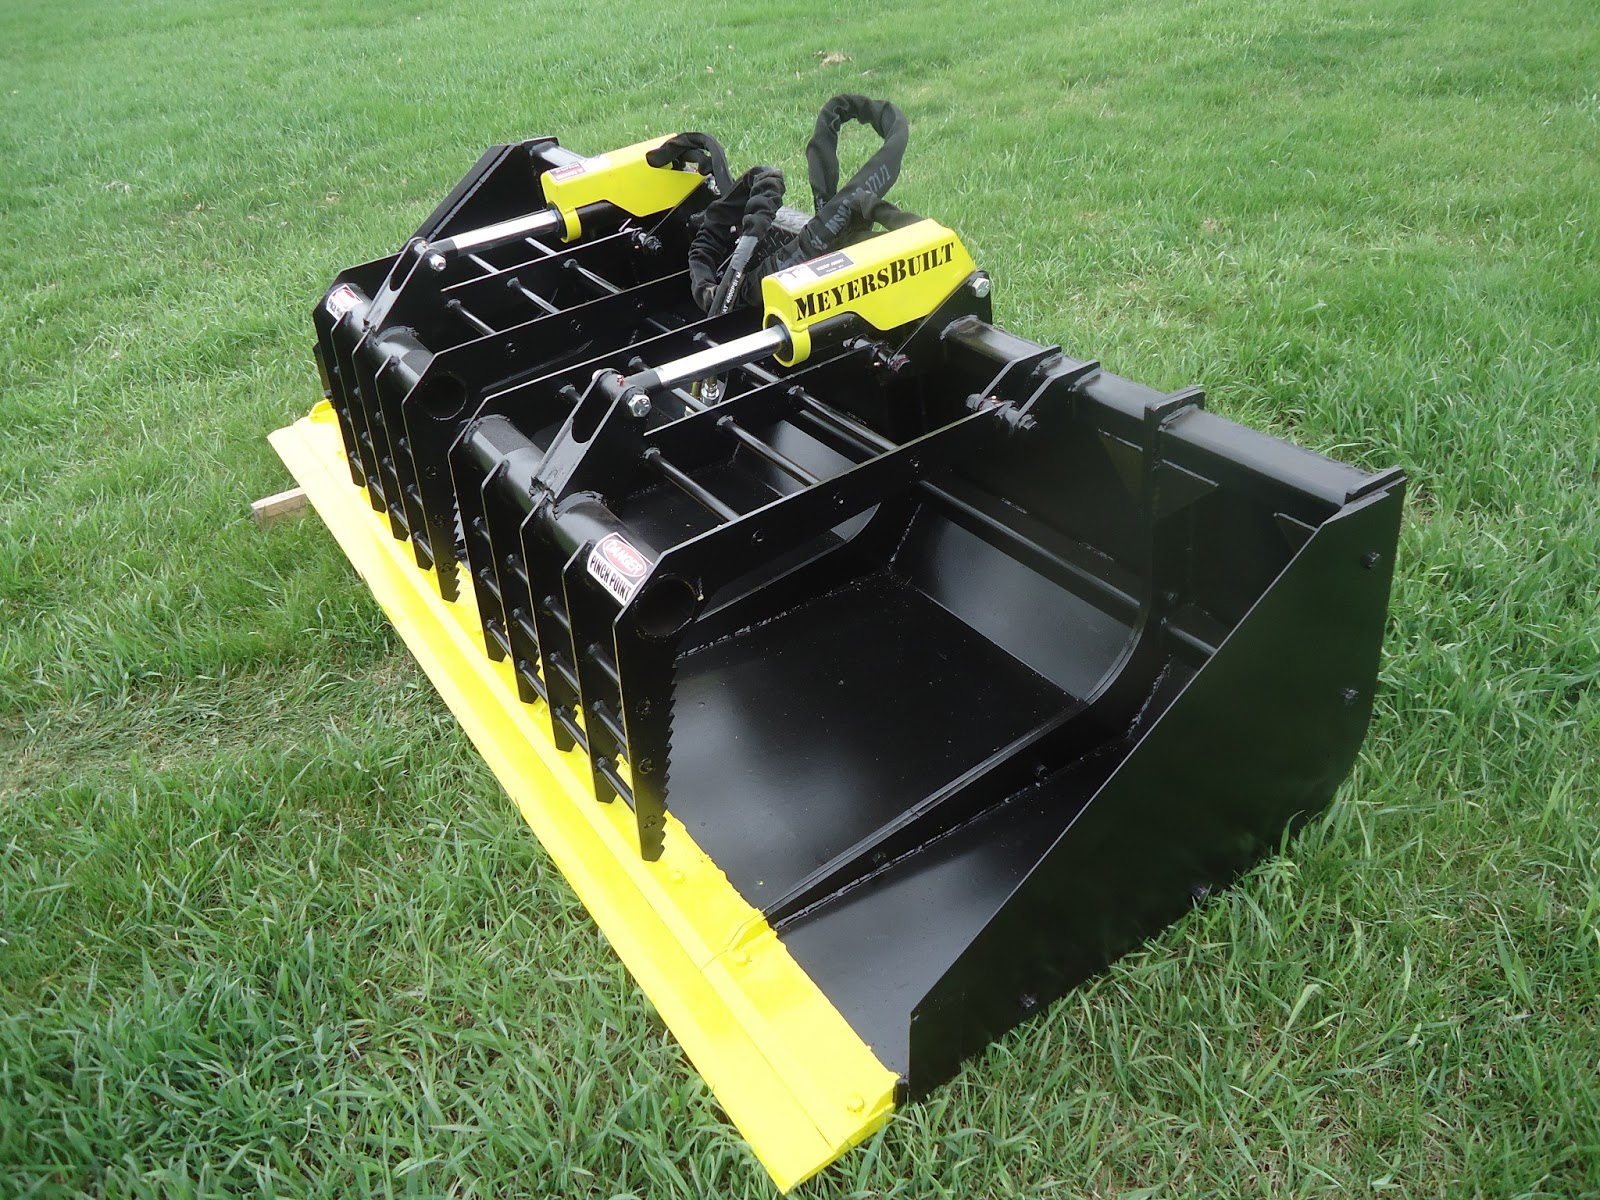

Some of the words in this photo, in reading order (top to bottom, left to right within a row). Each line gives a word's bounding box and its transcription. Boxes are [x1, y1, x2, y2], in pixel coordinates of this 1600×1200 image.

[589, 555, 610, 583] PINCH
[609, 573, 632, 602] POINT
[605, 542, 643, 575] DANGER
